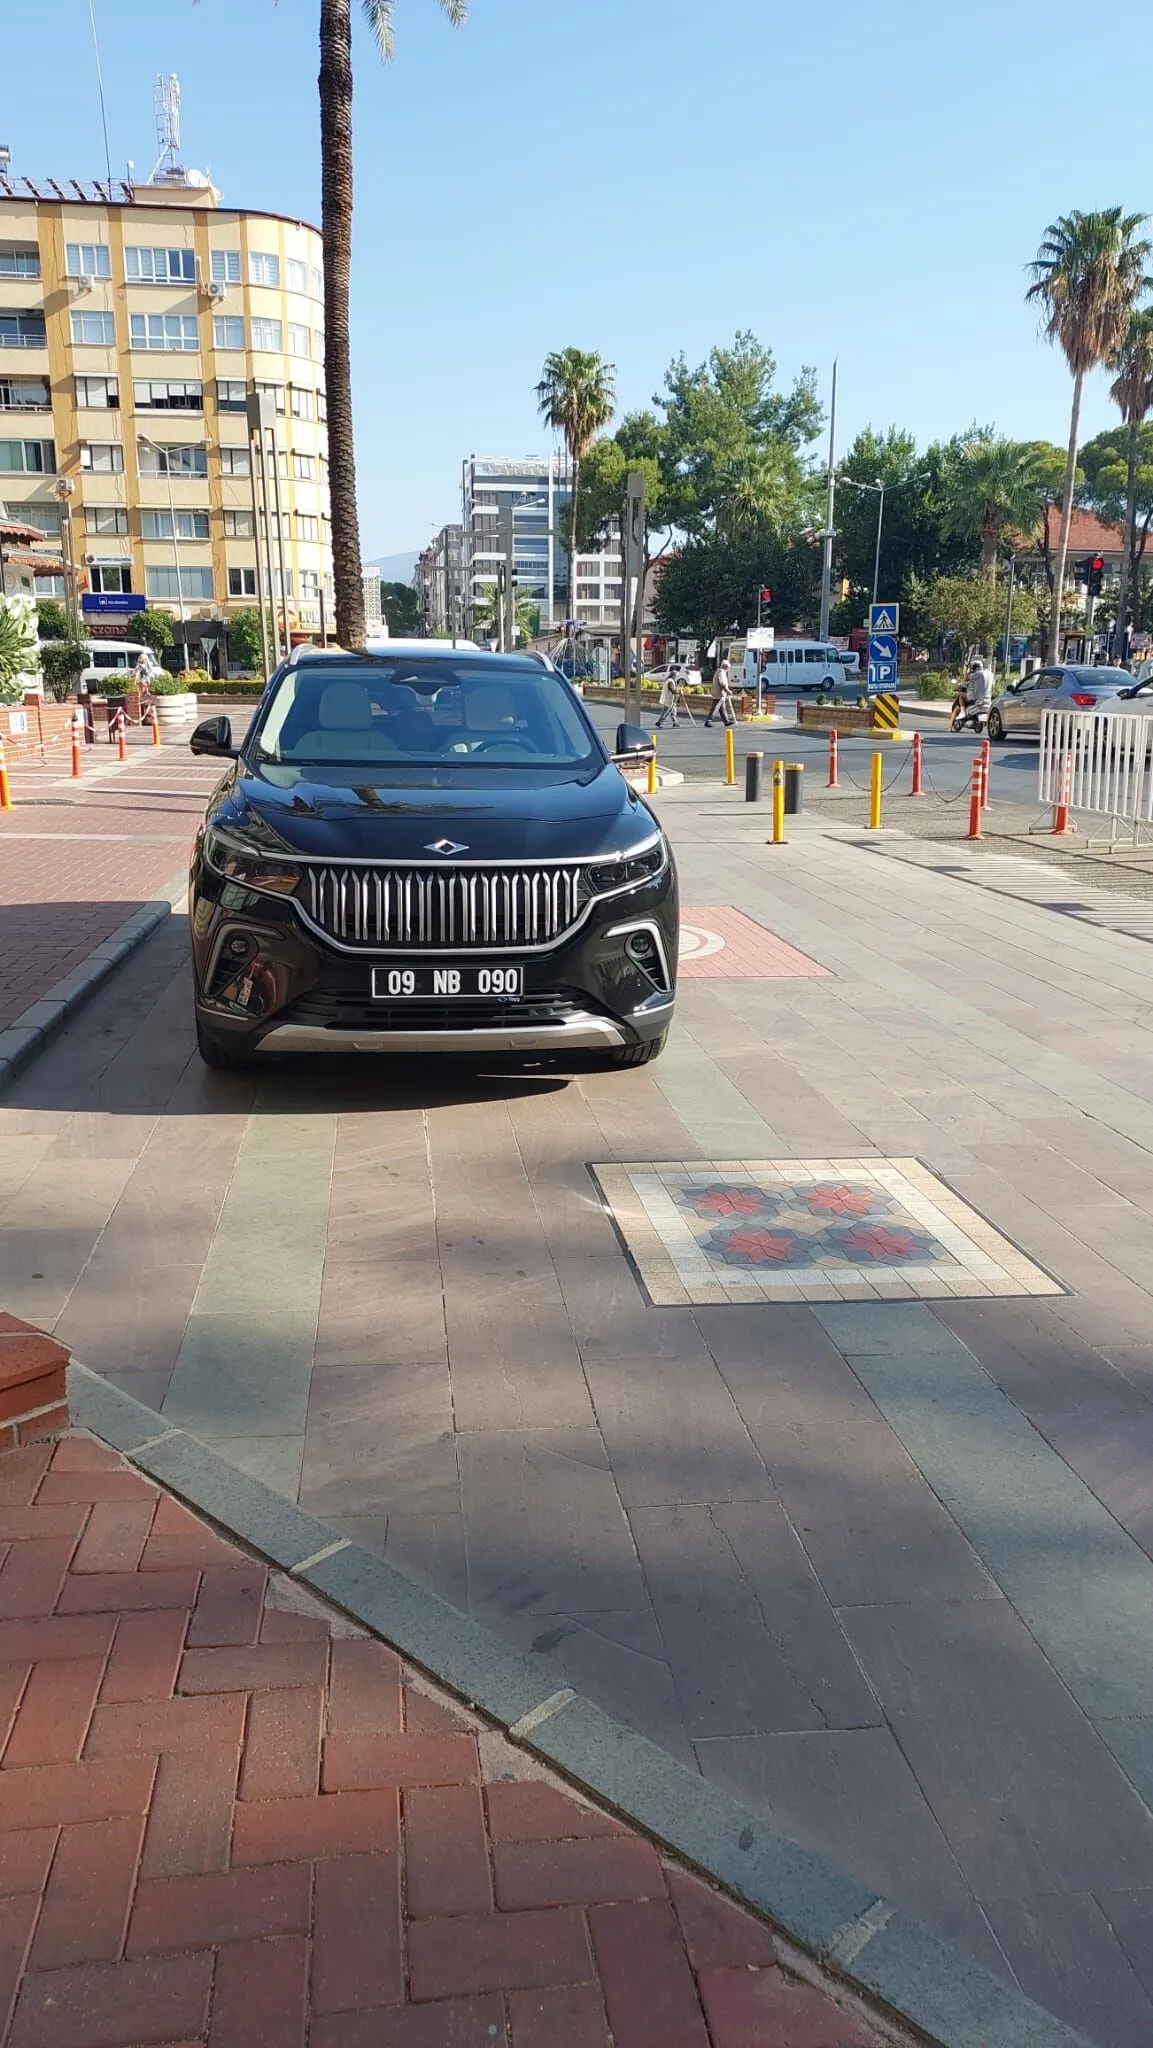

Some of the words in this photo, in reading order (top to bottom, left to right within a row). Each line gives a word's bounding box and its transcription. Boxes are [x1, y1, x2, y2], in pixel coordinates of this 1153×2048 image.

[880, 666, 890, 679] P
[388, 970, 415, 995] 09
[433, 970, 461, 994] NB
[478, 969, 518, 993] 090
